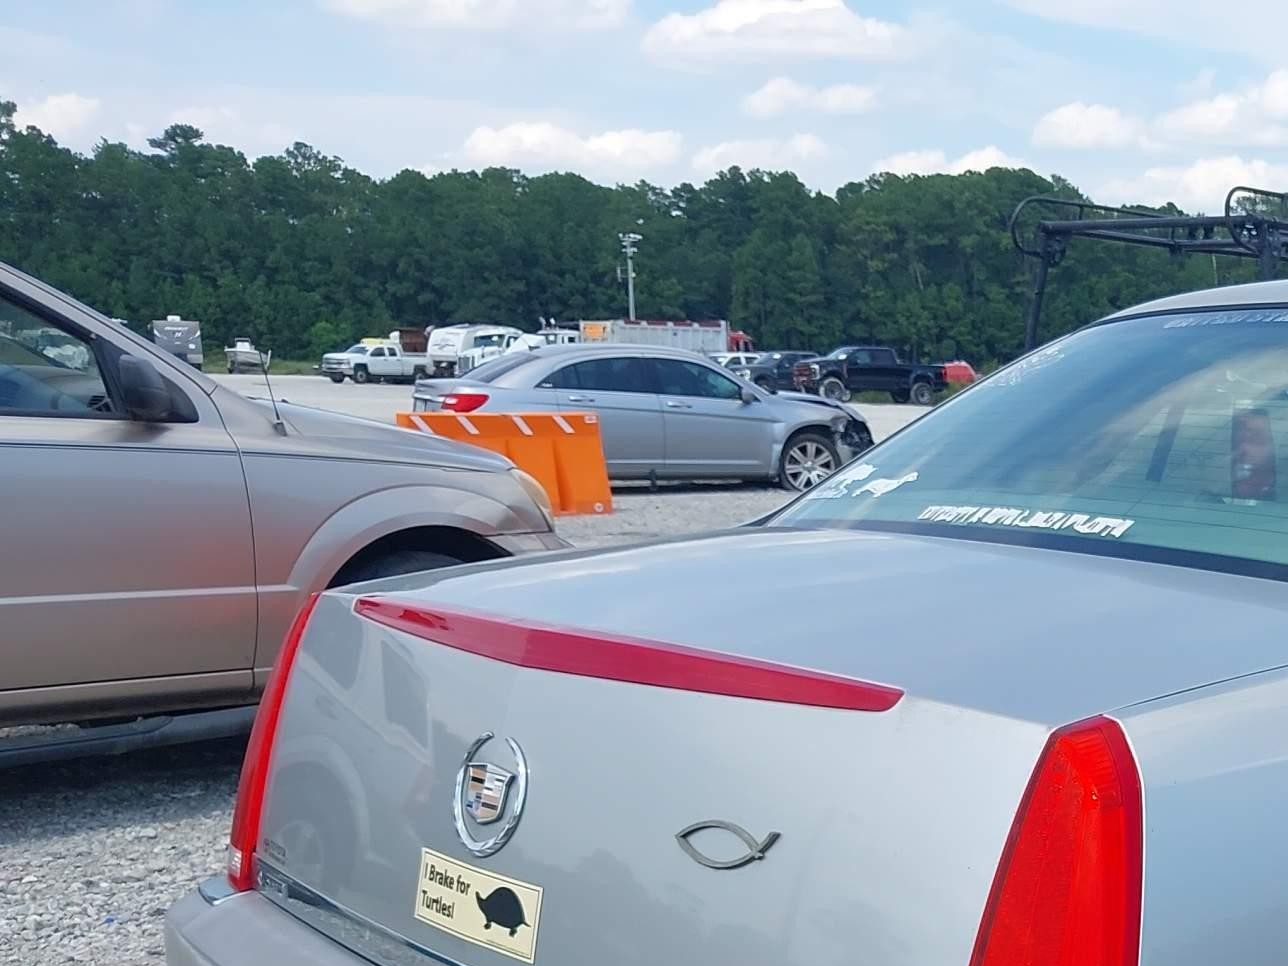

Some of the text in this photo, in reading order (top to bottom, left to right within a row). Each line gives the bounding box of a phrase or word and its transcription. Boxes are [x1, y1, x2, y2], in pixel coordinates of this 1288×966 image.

[424, 863, 472, 896] I Brake for
[421, 889, 456, 919] Turtles!
